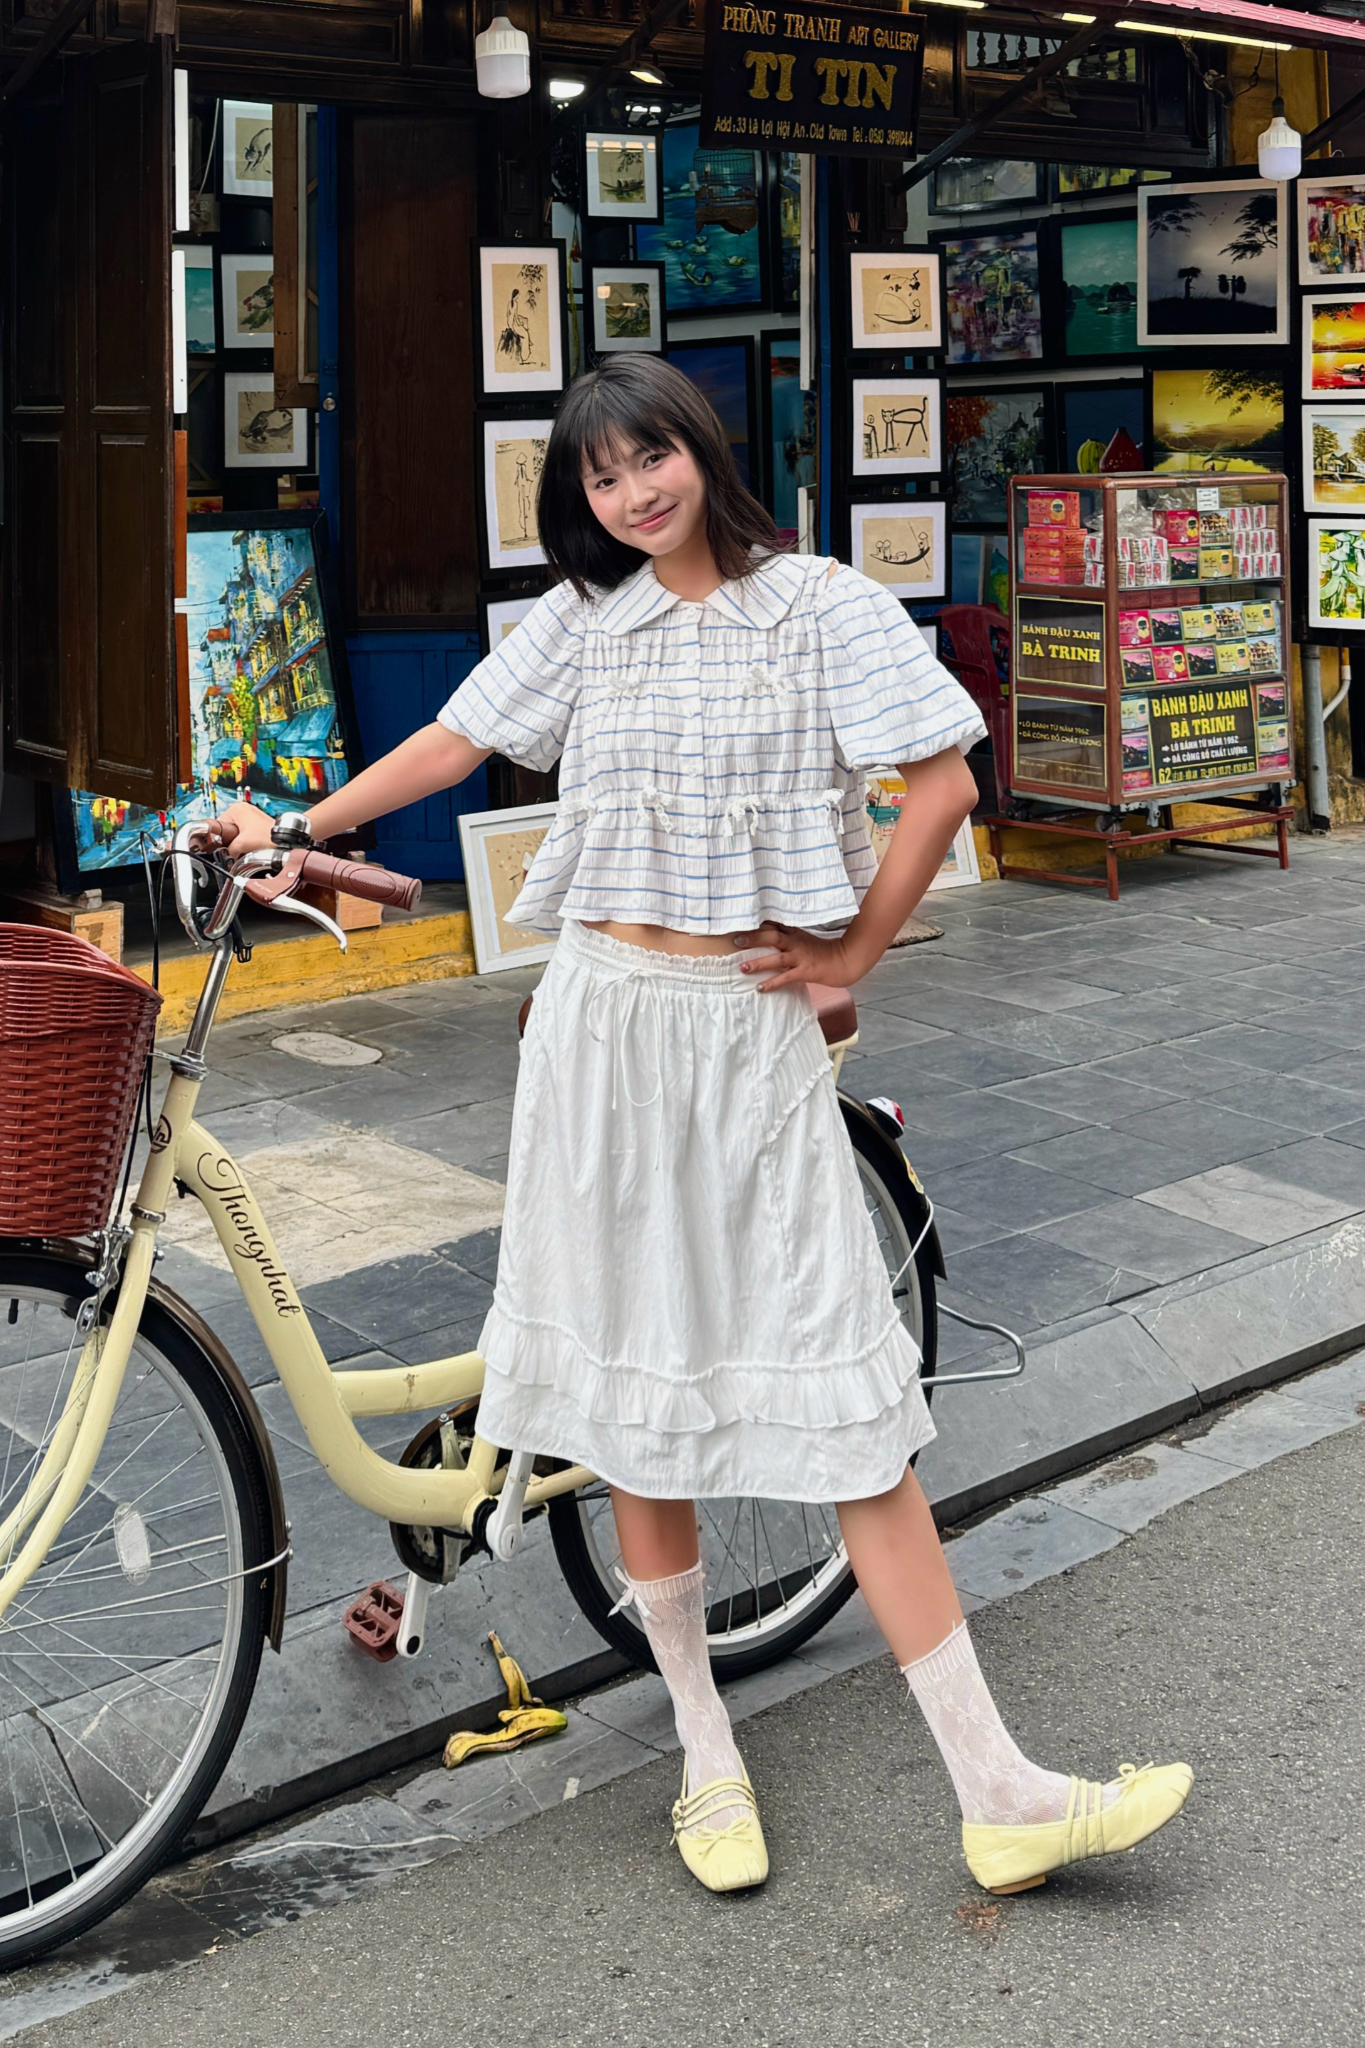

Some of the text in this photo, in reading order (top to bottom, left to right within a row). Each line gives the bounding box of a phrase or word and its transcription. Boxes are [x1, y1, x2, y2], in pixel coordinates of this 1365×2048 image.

[721, 1, 919, 52] PHÒNG TRANH ART GALLERY
[744, 50, 898, 111] TI TIN
[828, 124, 847, 142] Town
[1022, 623, 1049, 636] BÁNH
[1072, 629, 1101, 641] XANH
[1021, 638, 1101, 663] BÀ TRINH
[1151, 689, 1248, 717] BÁNH ĐẬU XANH
[1170, 714, 1236, 739] BÀ TRINH
[1158, 767, 1172, 784] 62
[197, 1152, 301, 1318] Thongnhat
